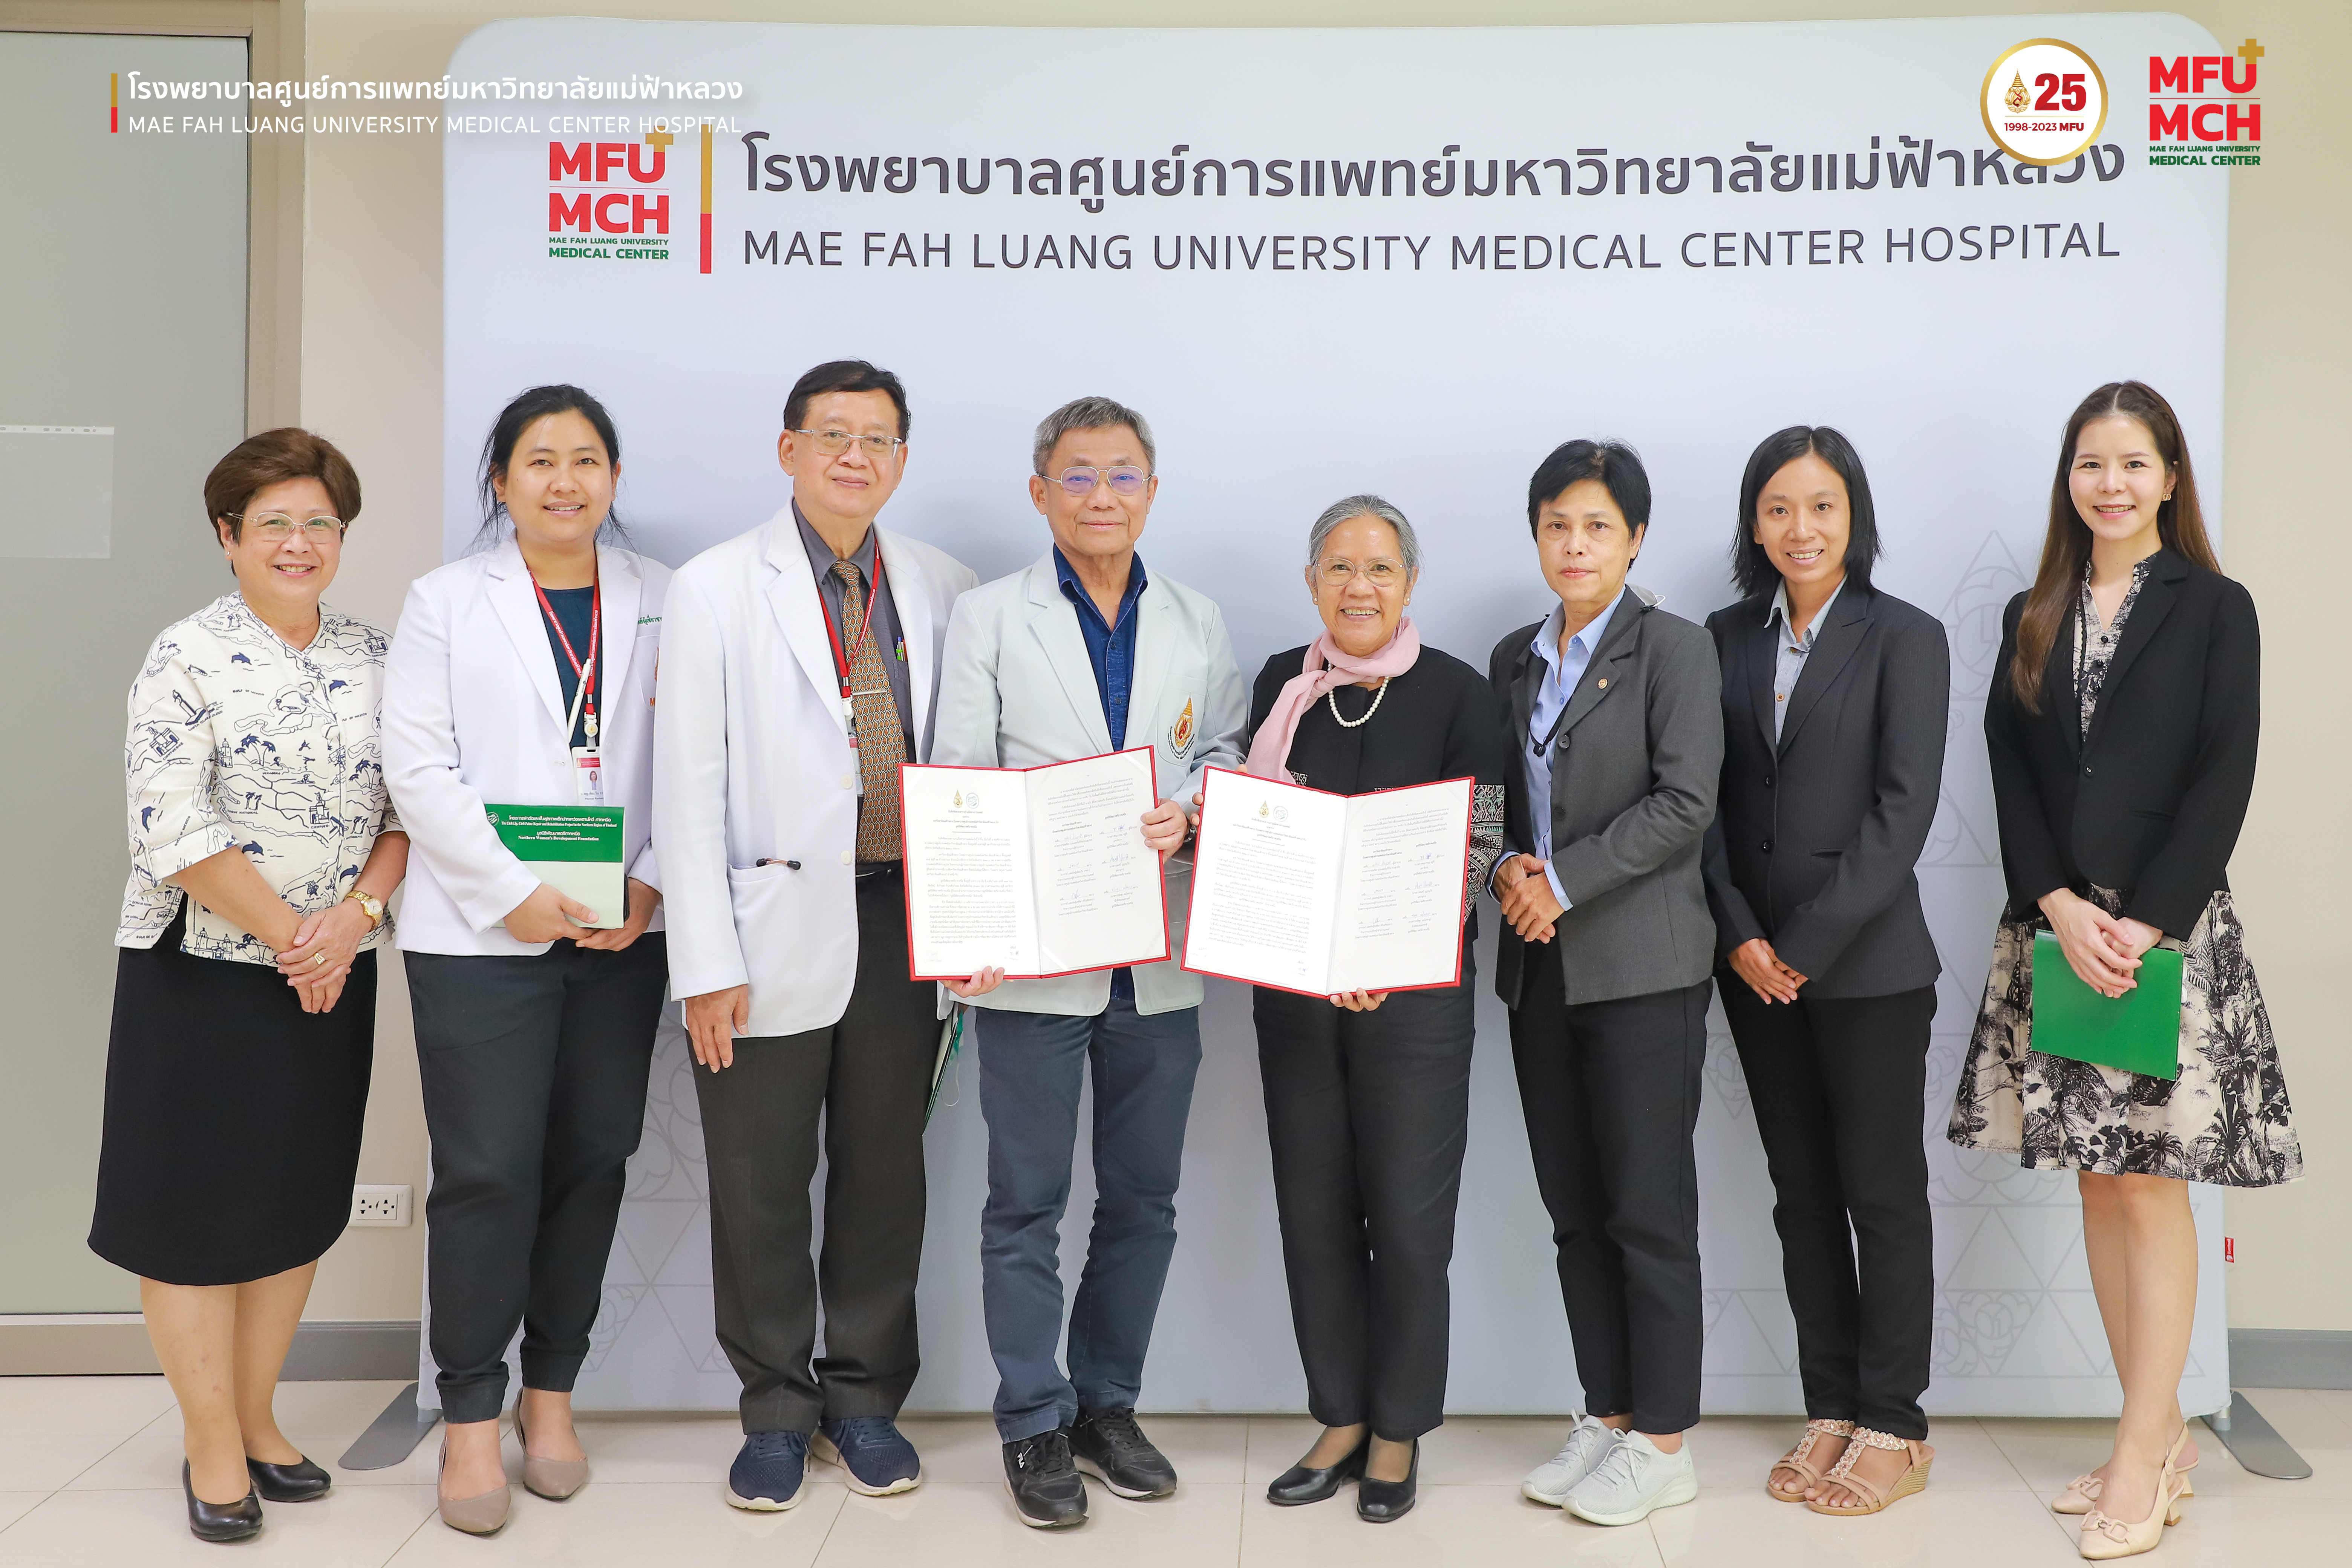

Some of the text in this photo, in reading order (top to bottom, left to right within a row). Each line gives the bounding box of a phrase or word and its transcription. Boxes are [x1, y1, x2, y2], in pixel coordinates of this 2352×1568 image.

[549, 142, 665, 183] MFU
[549, 193, 669, 234] MCH
[549, 247, 669, 260] MEDICAL CENTER
[744, 222, 2120, 271] MAE FAH LUANG UNIVERSITY MEDICAL CENTER HOSPITAL
